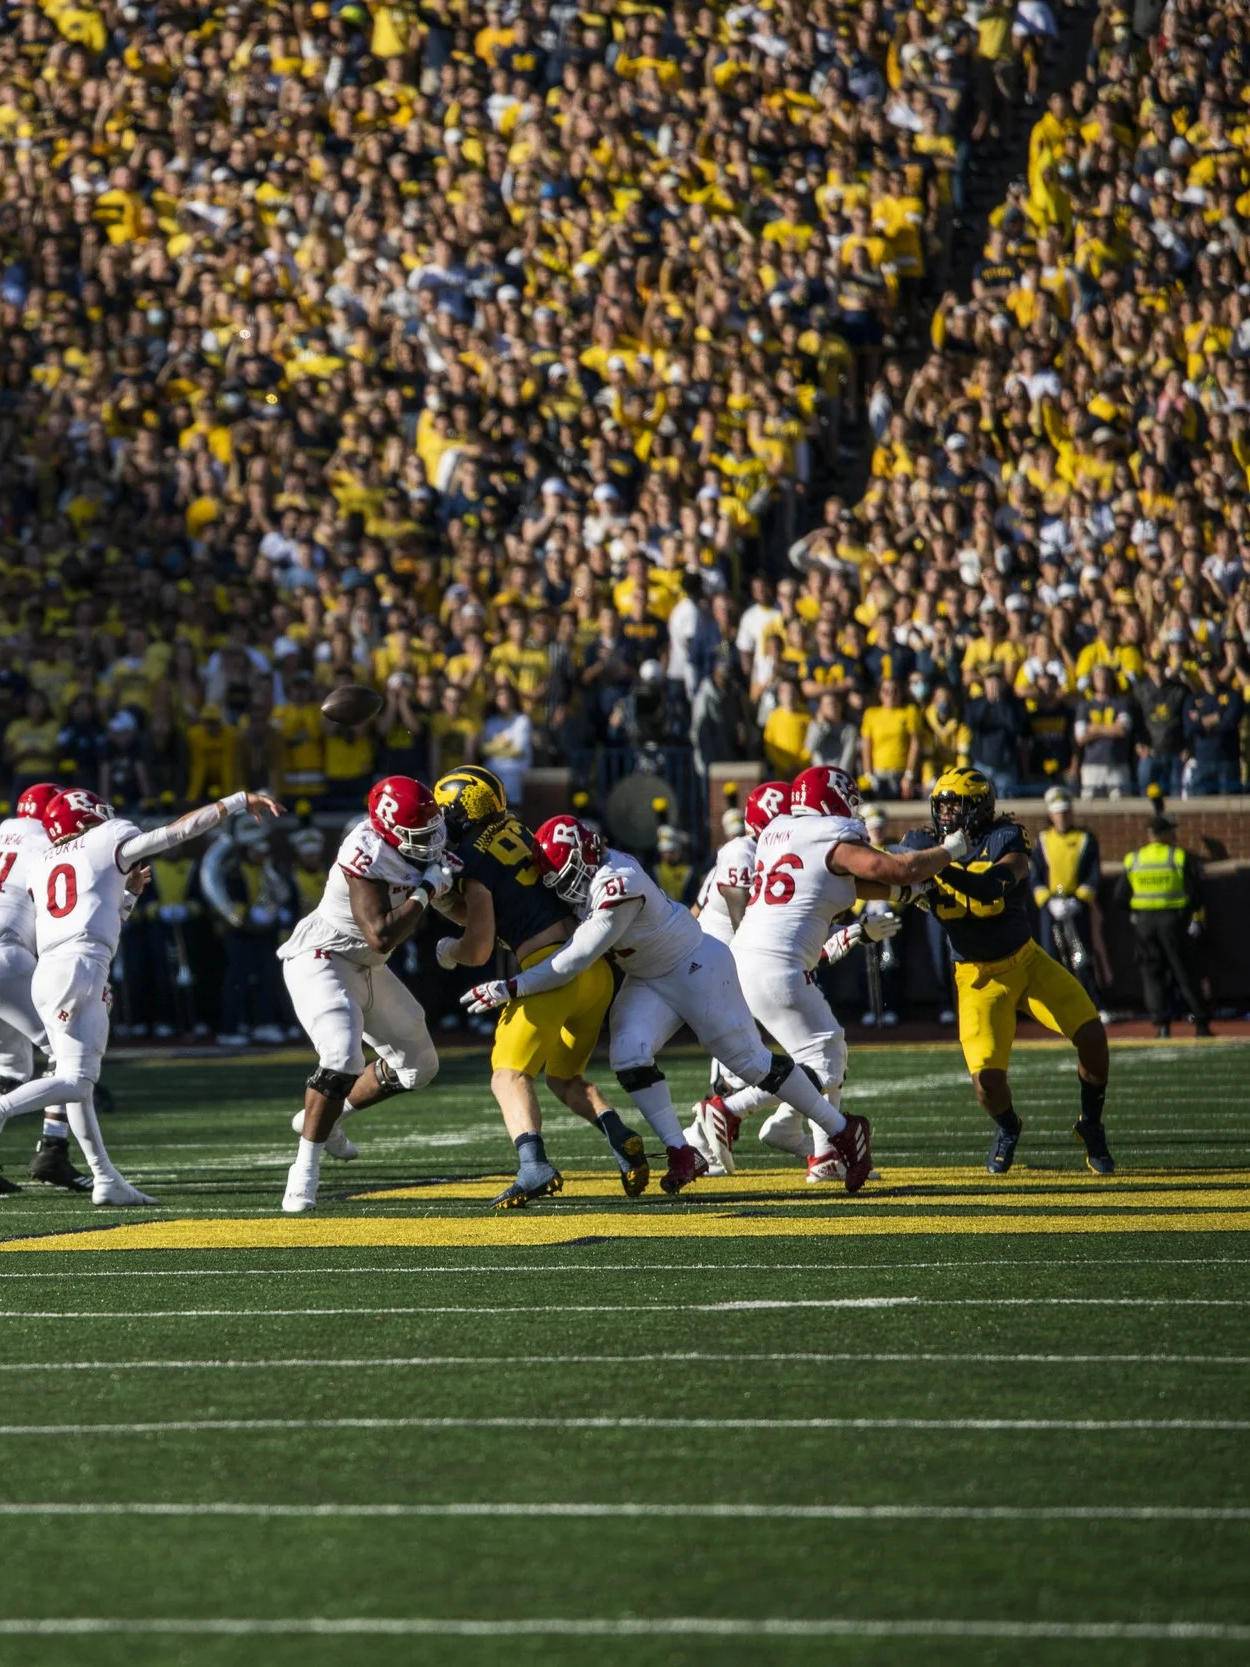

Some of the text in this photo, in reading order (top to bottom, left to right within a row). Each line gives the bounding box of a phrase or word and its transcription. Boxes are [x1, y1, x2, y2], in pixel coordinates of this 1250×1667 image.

[827, 770, 851, 794] R
[64, 792, 96, 811] R
[375, 794, 399, 824] R
[757, 788, 784, 814] R
[553, 823, 579, 847] R
[350, 847, 373, 874] 72
[728, 868, 750, 887] 54
[46, 863, 78, 919] 0
[58, 1009, 70, 1023] R
